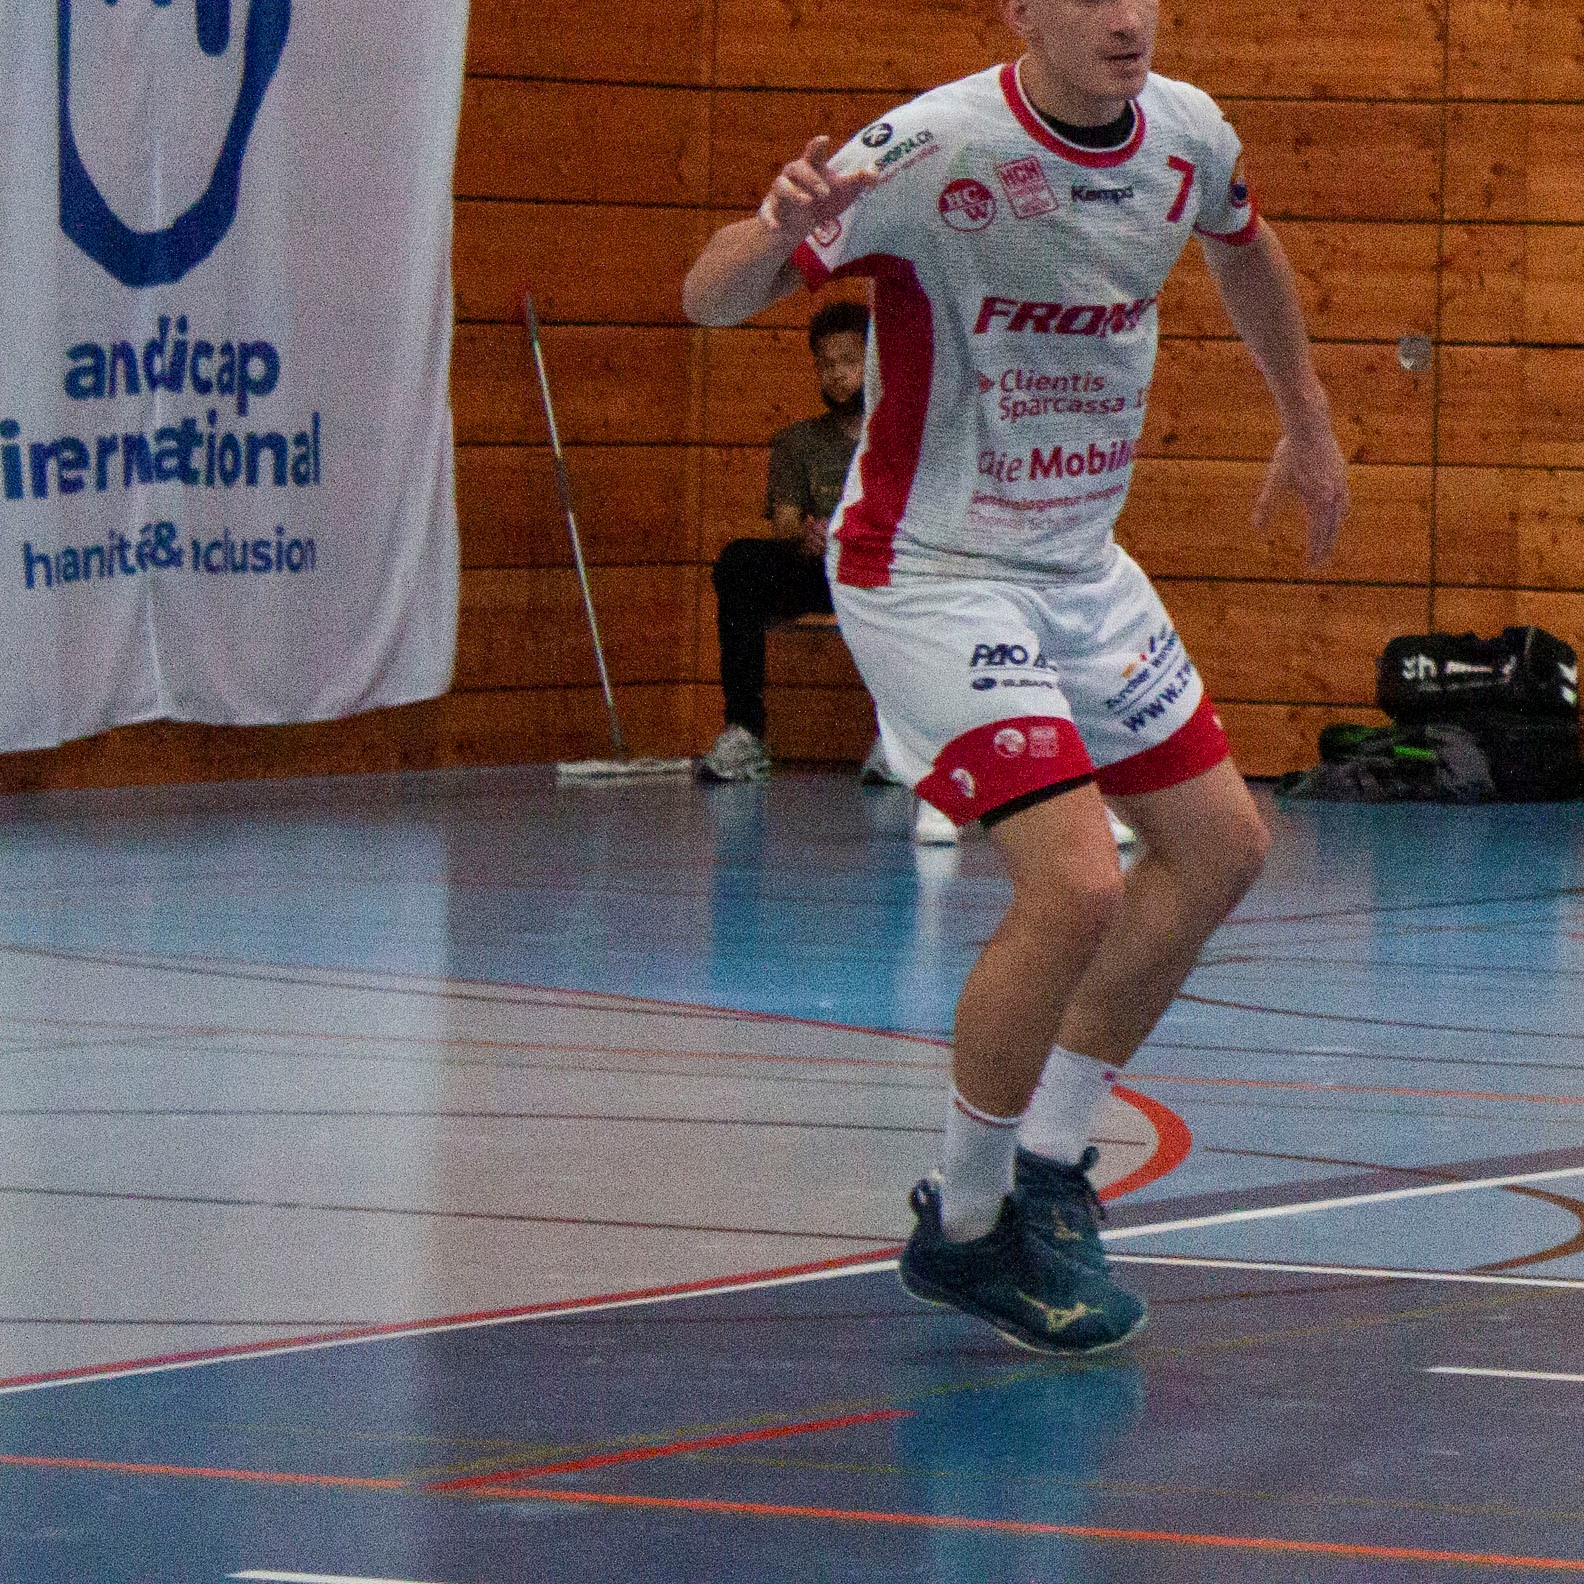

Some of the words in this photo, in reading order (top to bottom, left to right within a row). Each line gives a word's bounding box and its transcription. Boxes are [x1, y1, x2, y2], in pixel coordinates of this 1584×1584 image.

[1165, 155, 1198, 223] 7
[973, 296, 1160, 339] FROM
[999, 368, 1107, 394] Clientis
[998, 395, 1127, 423] Sparcassa
